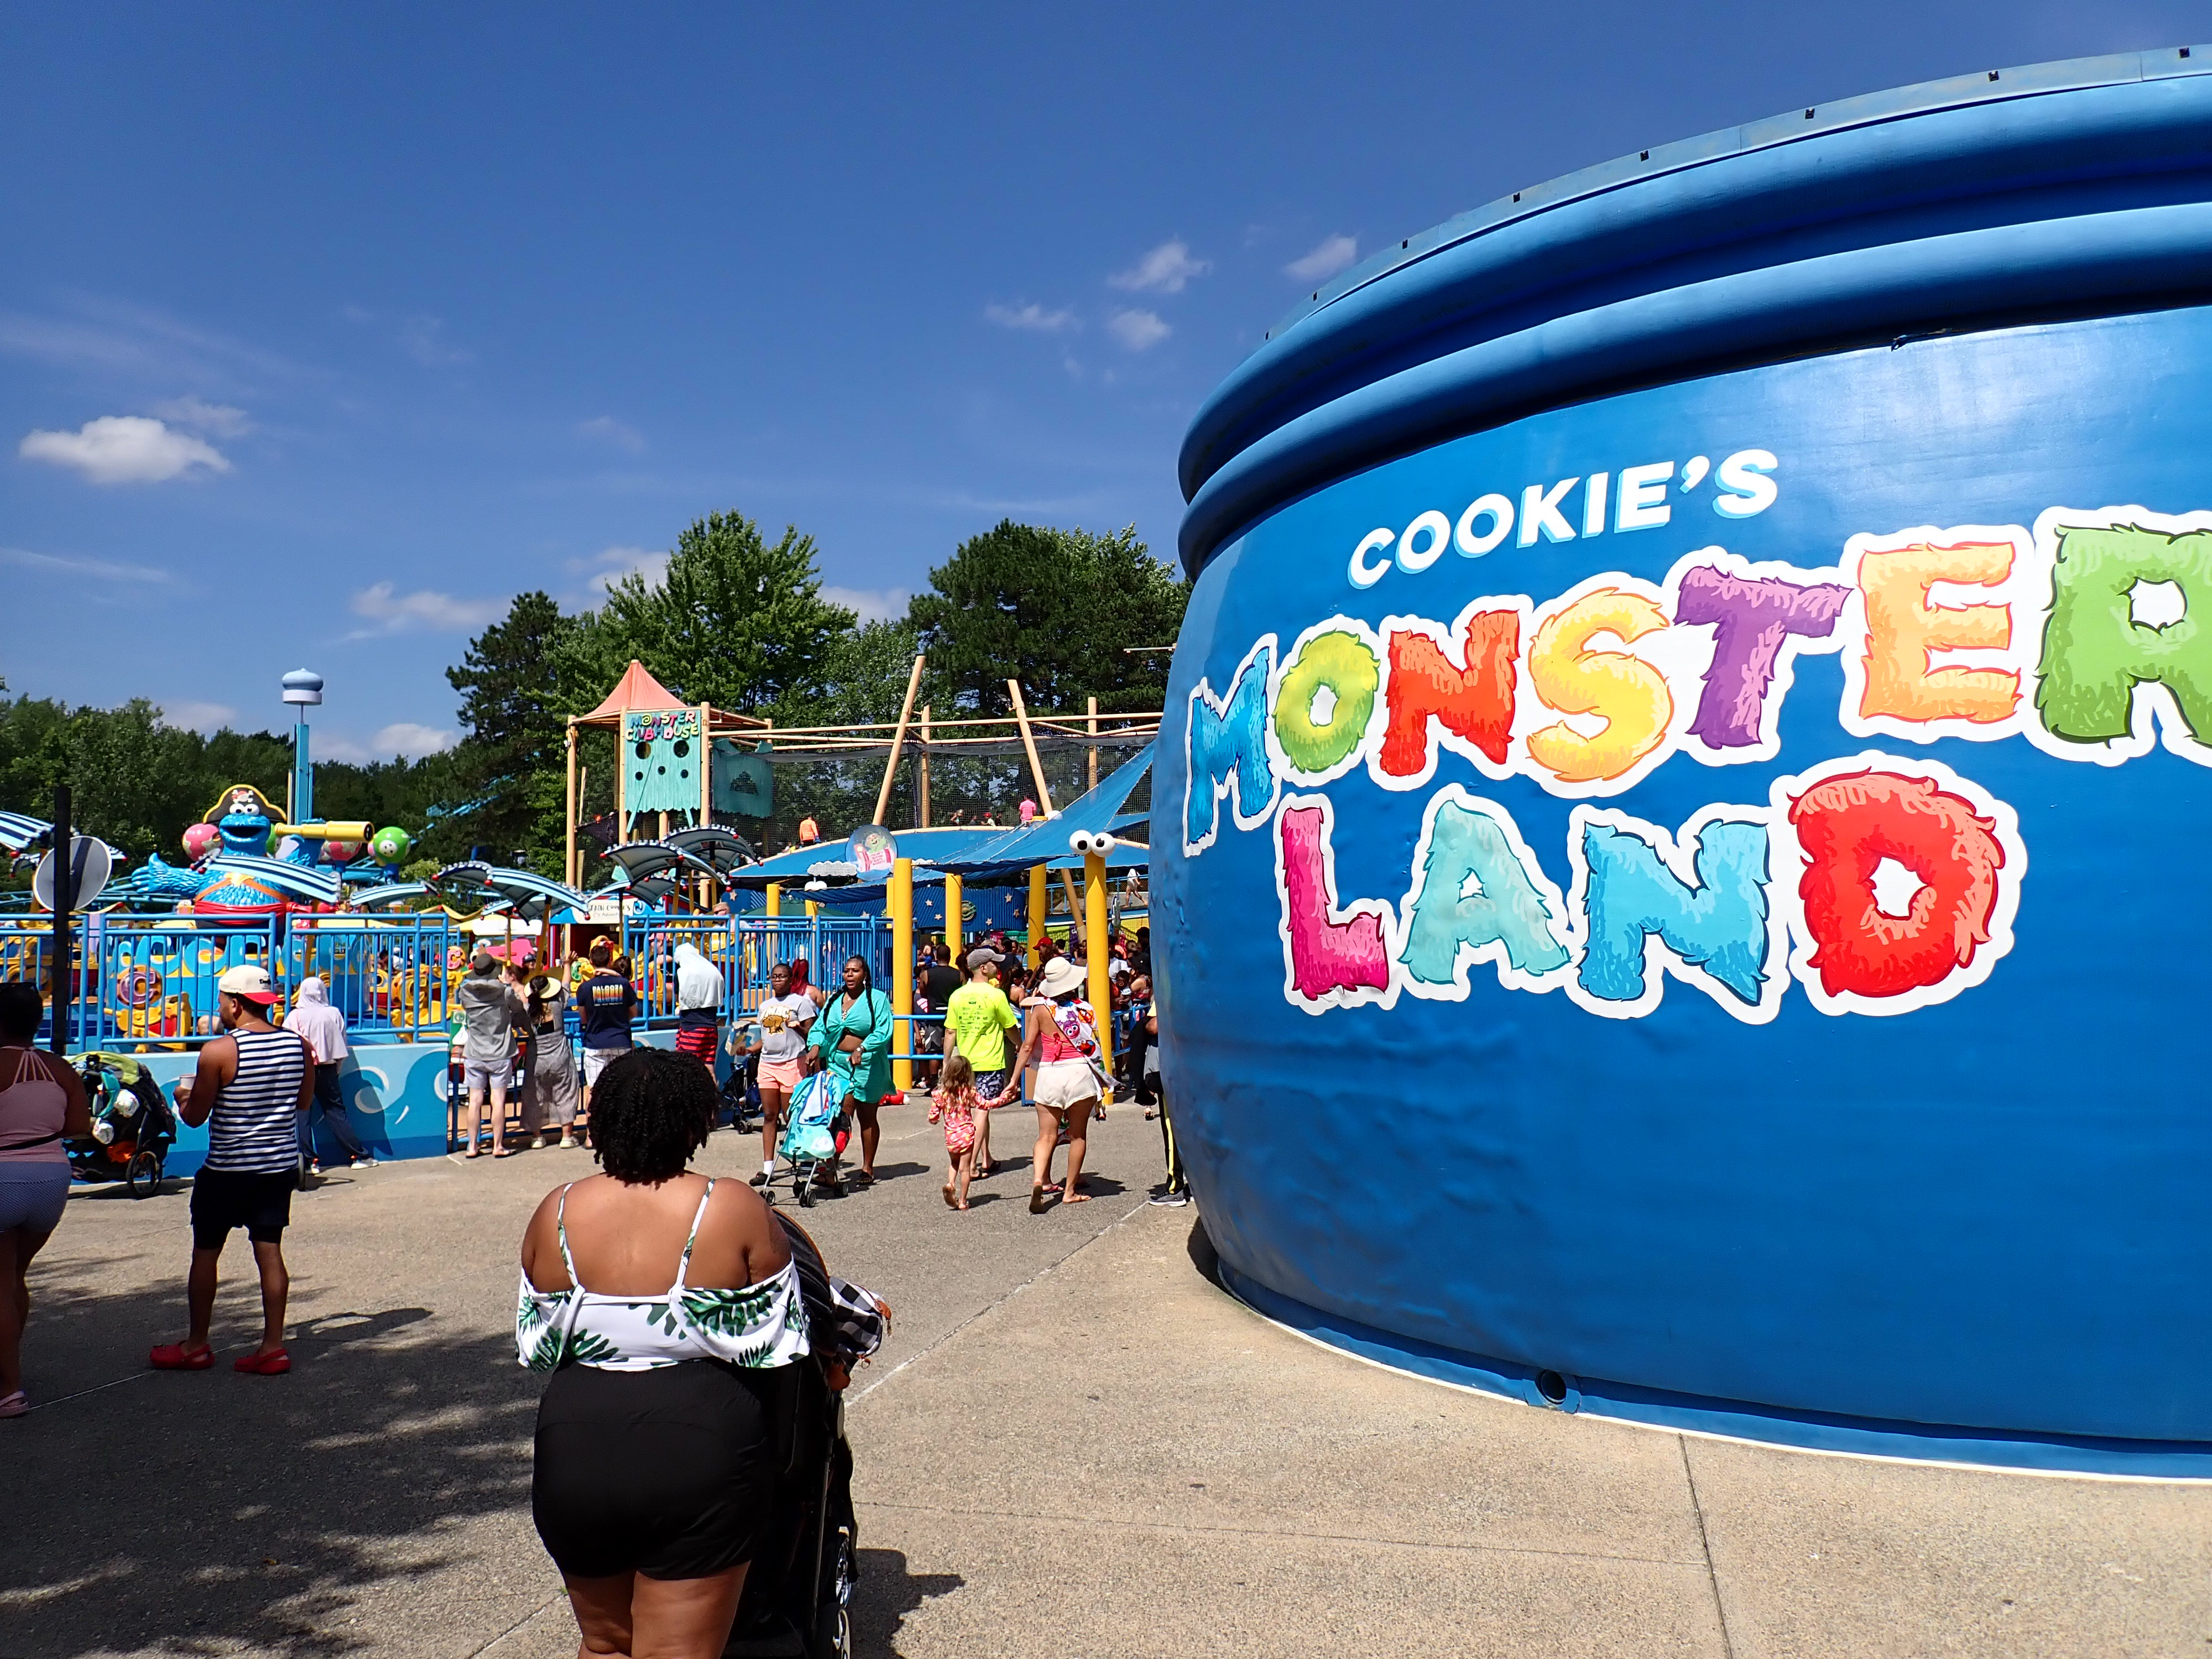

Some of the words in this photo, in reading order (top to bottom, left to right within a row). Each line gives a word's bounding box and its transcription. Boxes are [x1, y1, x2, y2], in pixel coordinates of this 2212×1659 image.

[1347, 448, 1778, 589] COOKIE'S
[630, 710, 696, 728] MONSTER
[1186, 521, 2212, 846] MONSTER
[625, 723, 699, 742] CLUBHOUSE
[1279, 766, 2007, 1005] LAND
[592, 984, 623, 1003] PALOOZA
